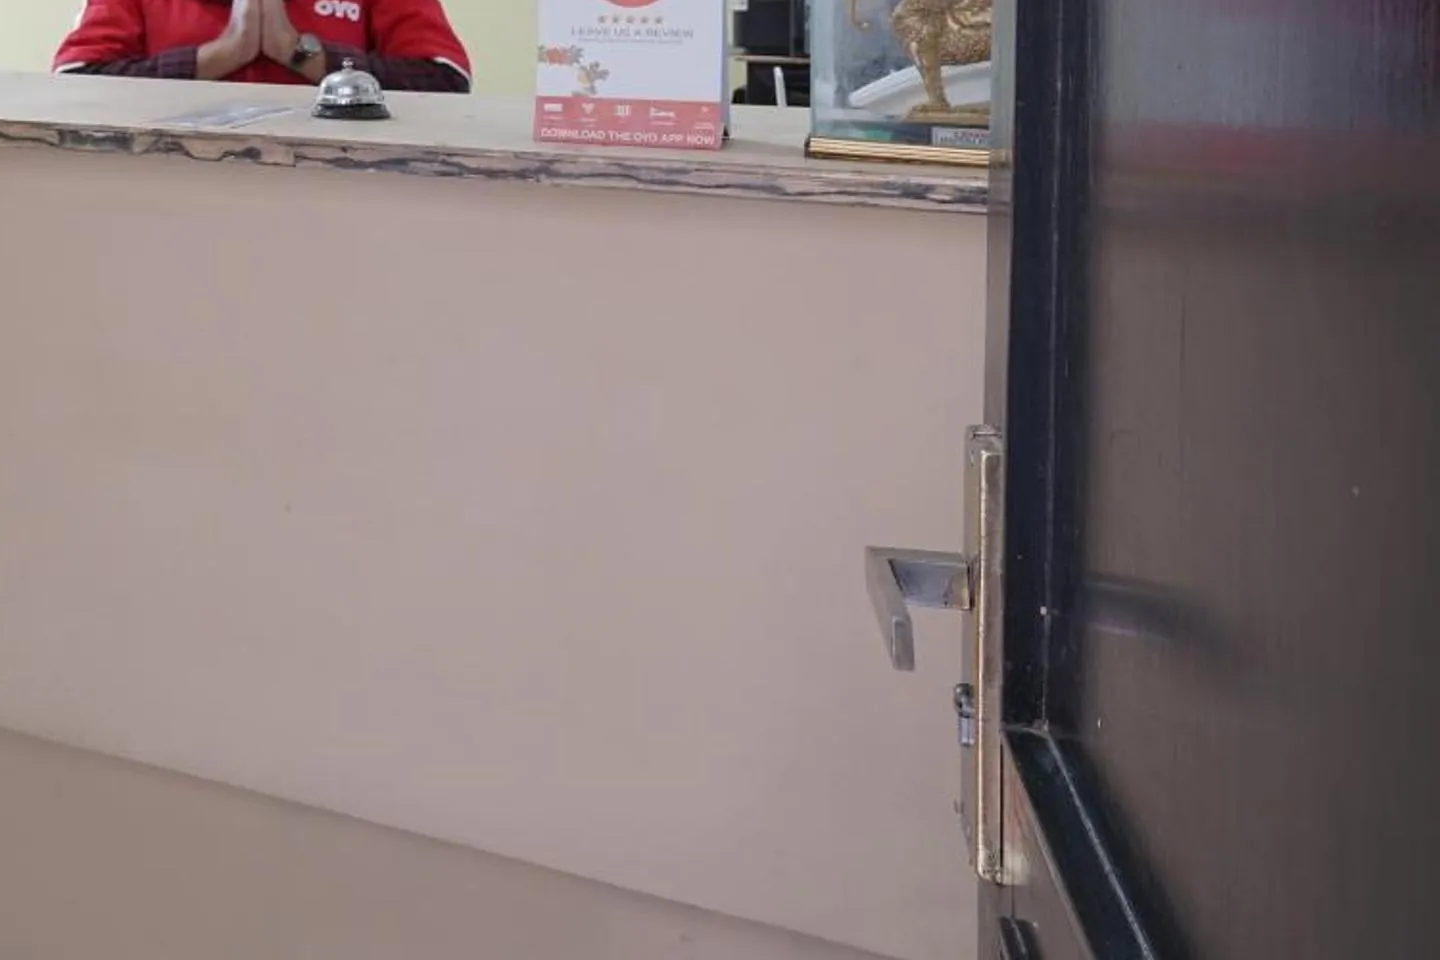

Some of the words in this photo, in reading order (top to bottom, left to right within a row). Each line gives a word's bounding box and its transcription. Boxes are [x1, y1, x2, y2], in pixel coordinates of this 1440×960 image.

[313, 0, 360, 22] OYO
[540, 127, 606, 140] DOWNLOAD
[607, 131, 633, 141] THE
